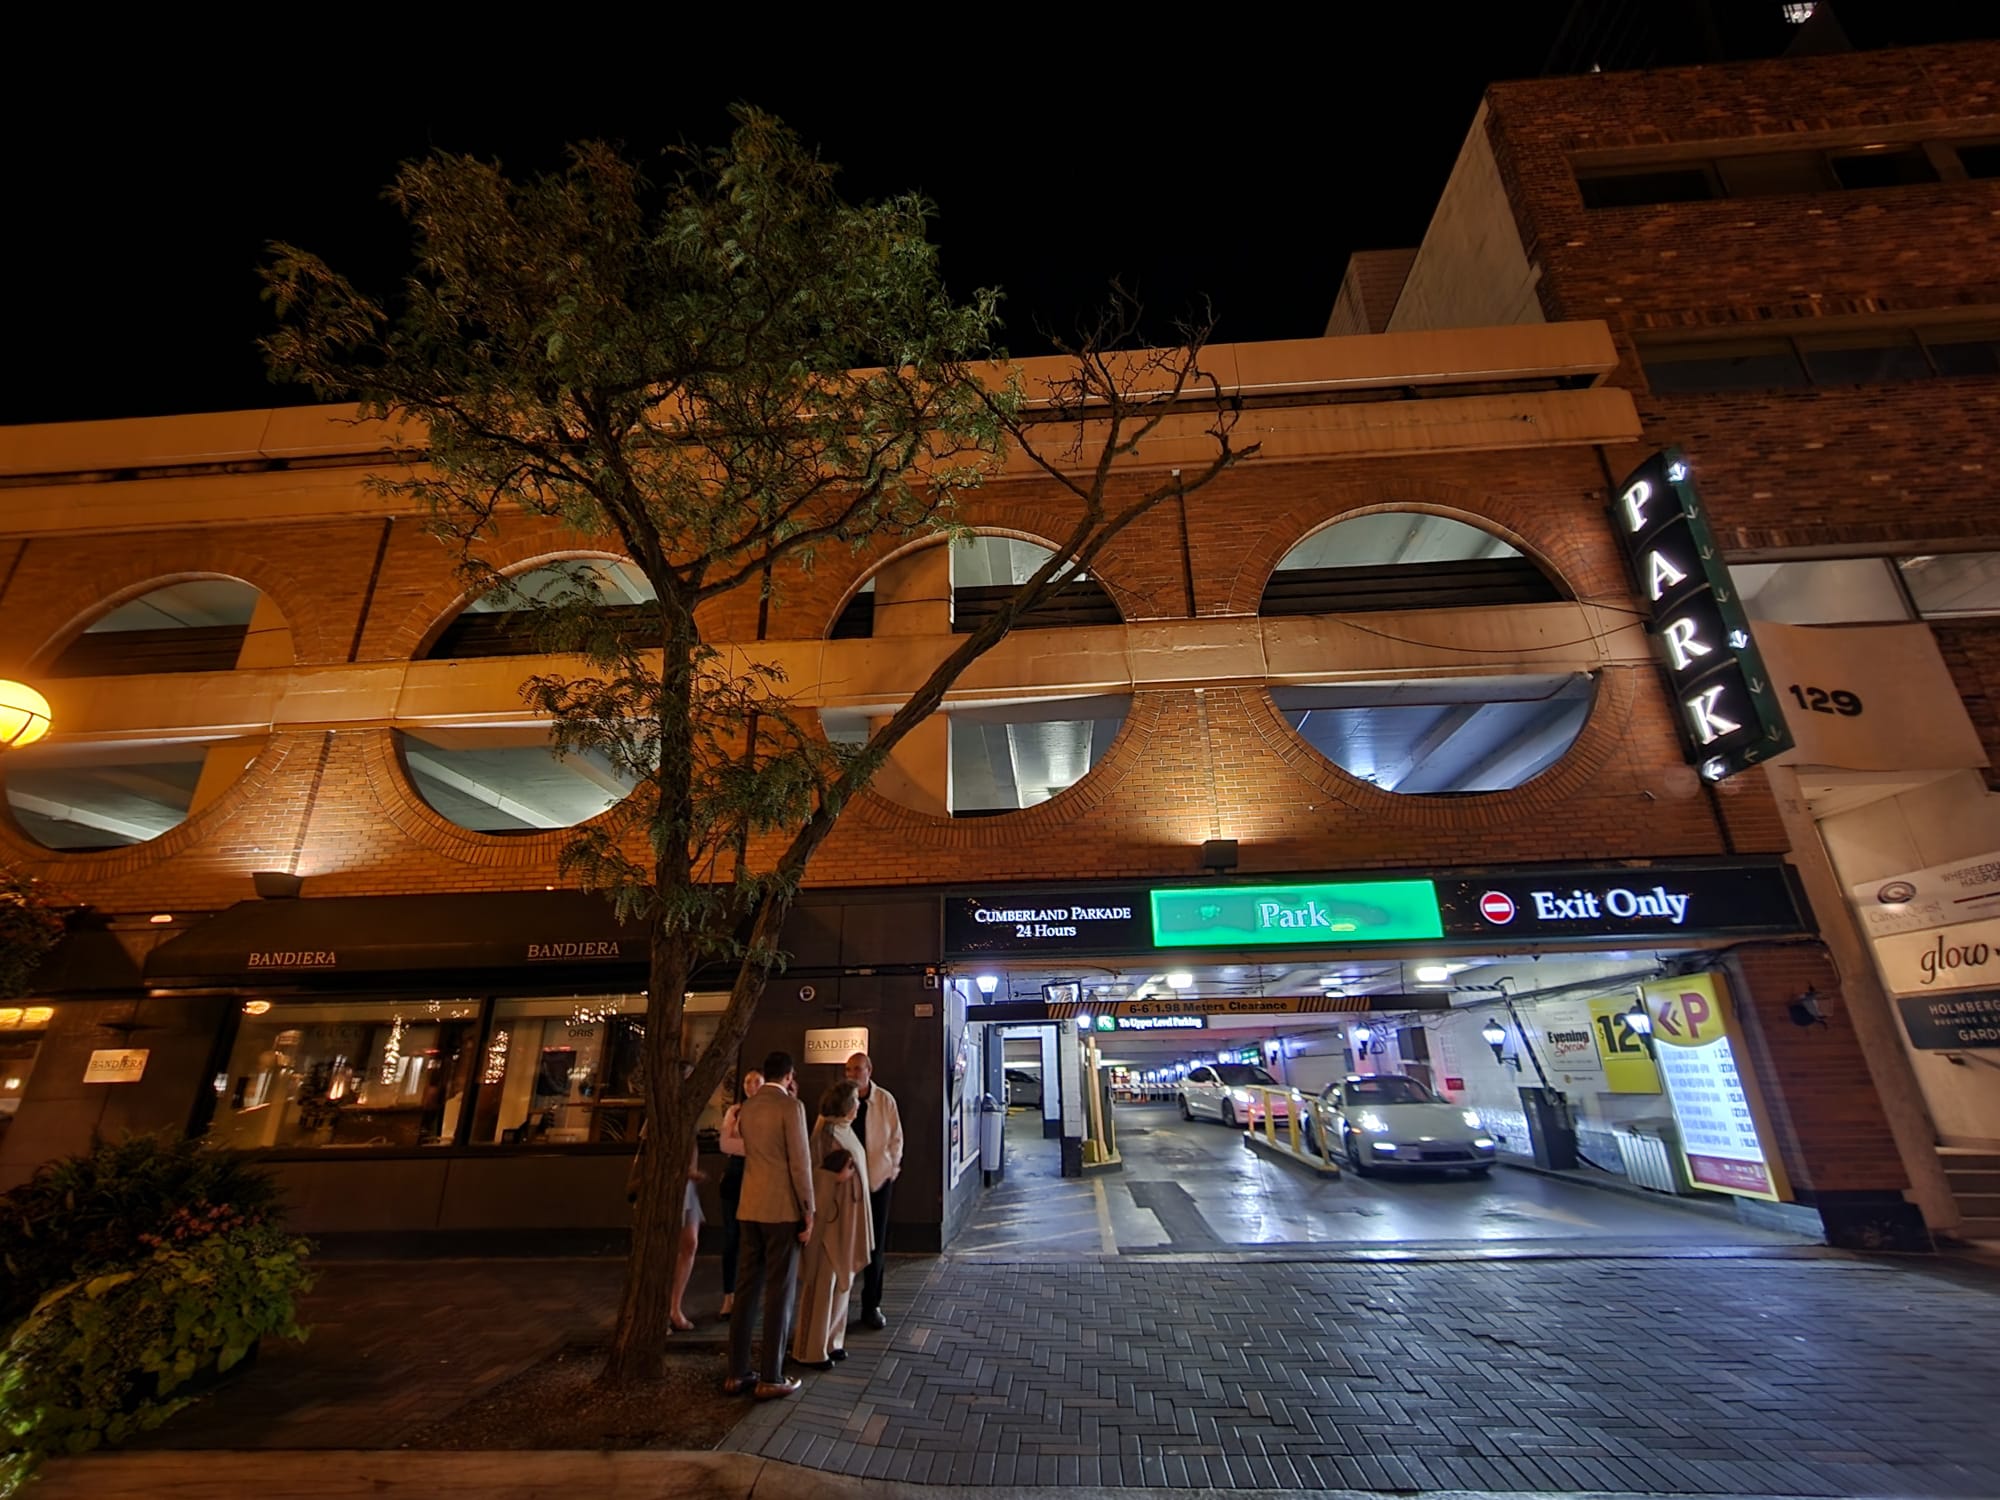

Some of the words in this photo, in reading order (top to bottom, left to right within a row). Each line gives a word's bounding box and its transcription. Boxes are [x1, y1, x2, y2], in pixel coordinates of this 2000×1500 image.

[1622, 480, 1741, 744] PARK
[1789, 684, 1863, 717] 129
[1530, 889, 1601, 919] Exit
[1606, 886, 1690, 924] Only
[974, 908, 1068, 923] CUMBERLAND
[1071, 906, 1132, 920] PARKADE
[1259, 900, 1330, 929] Park
[1016, 925, 1032, 937] 24
[1034, 924, 1077, 937] Hours
[527, 941, 620, 958] BANDIERA
[248, 951, 337, 967] BANDIERA
[1920, 934, 1989, 985] glow
[1183, 1002, 1225, 1012] Meters
[1229, 1000, 1288, 1011] Clearance
[1680, 992, 1710, 1039] P
[807, 1039, 866, 1049] BANDIERA
[1547, 1029, 1590, 1044] Evening
